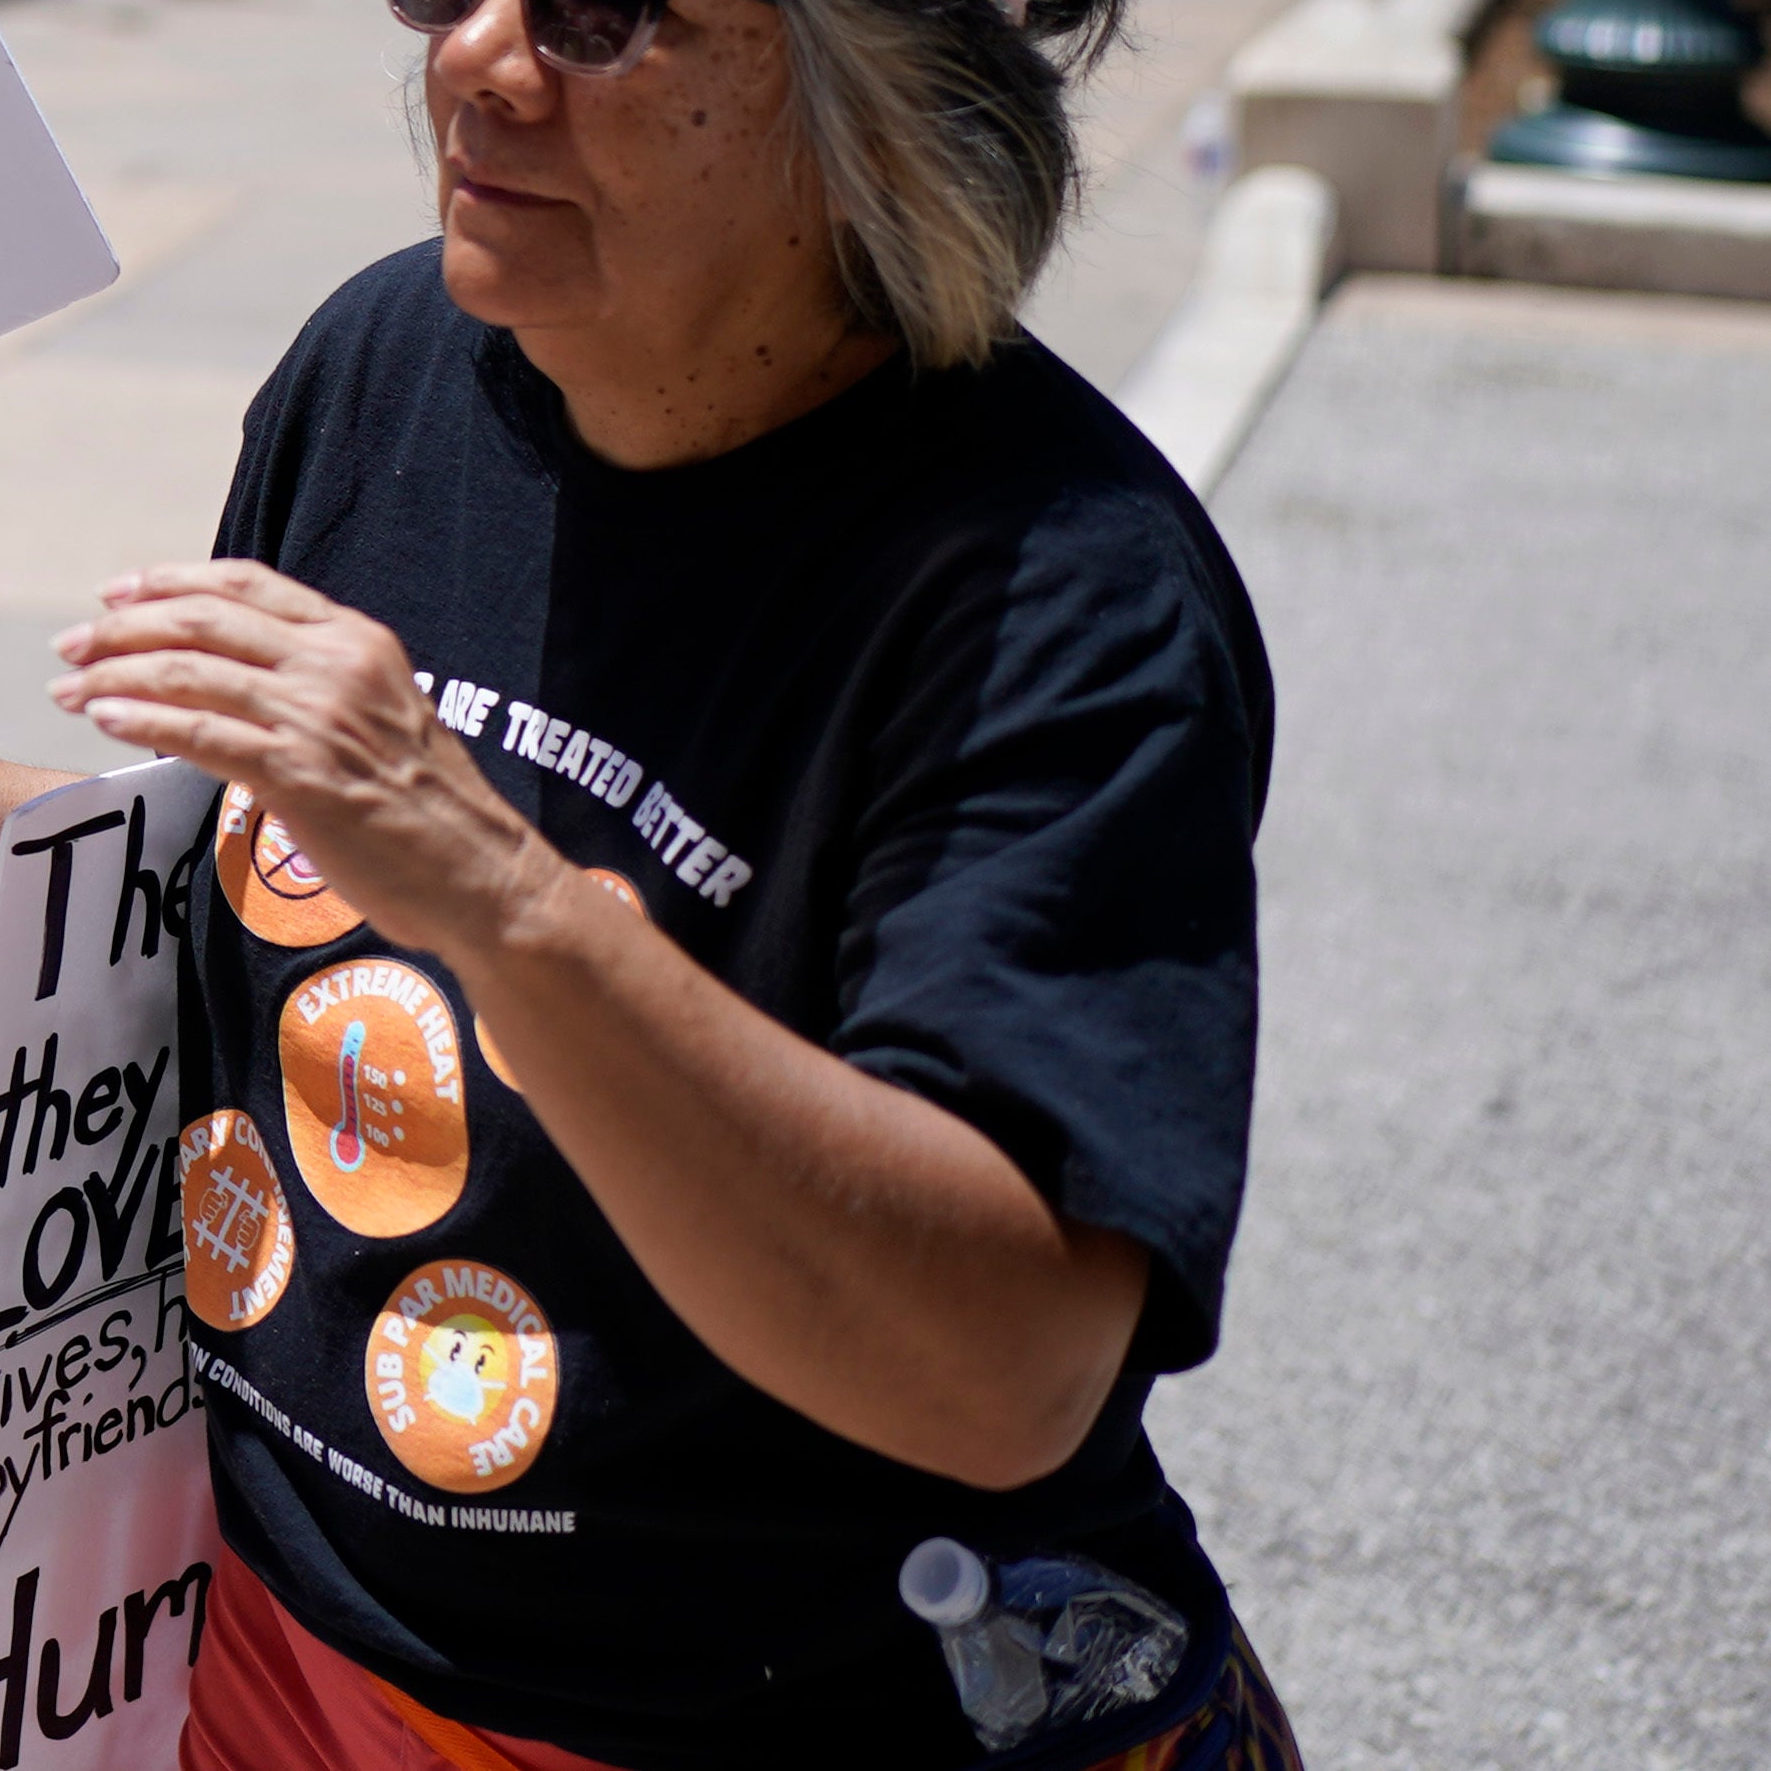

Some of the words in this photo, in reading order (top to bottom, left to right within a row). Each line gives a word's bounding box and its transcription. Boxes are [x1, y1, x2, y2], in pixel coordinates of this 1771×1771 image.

[437, 679, 499, 737] ARE
[502, 700, 644, 808] TREATED
[632, 781, 752, 908] BETTER
[296, 966, 430, 1025] EXTREME
[416, 1004, 459, 1104] HEAT
[363, 1065, 387, 1089] 150
[363, 1093, 387, 1117] 125
[365, 1124, 389, 1148] 100
[383, 1278, 443, 1347] PAR
[442, 1267, 548, 1389] MEDICAL
[376, 1353, 416, 1433] SUB
[208, 1358, 291, 1438] CONDITIONS
[293, 1425, 324, 1462] ARE
[328, 1447, 383, 1501] WORSE
[386, 1484, 445, 1527] THAN
[451, 1506, 576, 1533] INHUMANE
[469, 1397, 540, 1477] CARE
